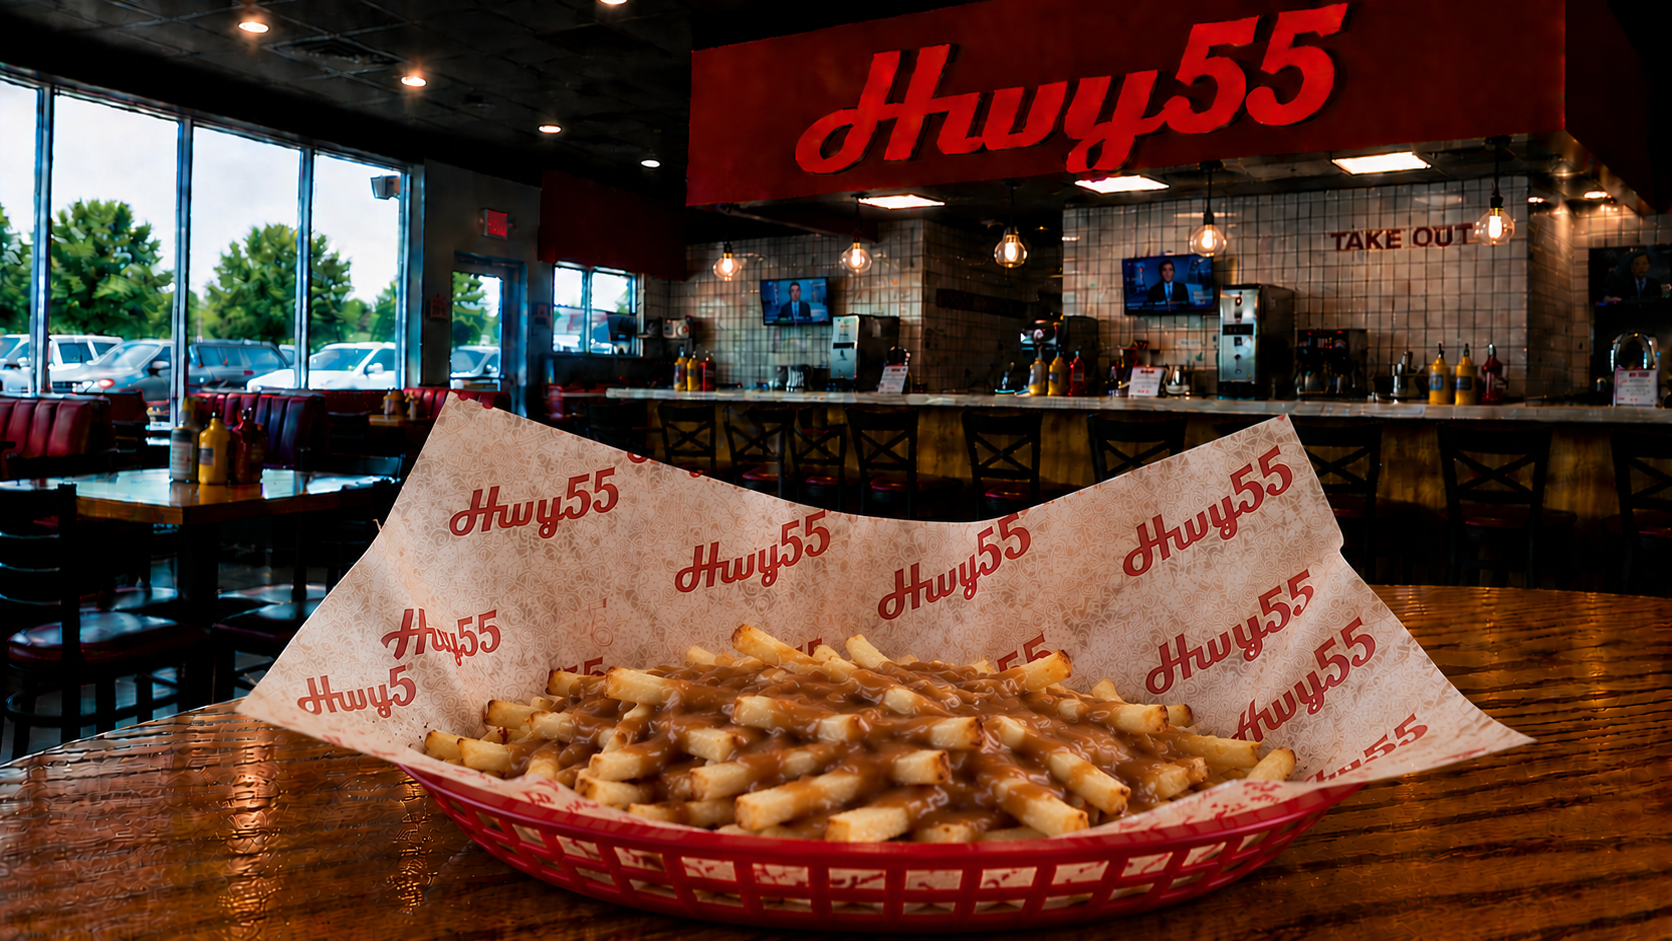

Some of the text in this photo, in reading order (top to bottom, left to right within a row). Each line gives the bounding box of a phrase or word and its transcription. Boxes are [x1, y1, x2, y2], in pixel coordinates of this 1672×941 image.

[795, 2, 1349, 174] Hwy55
[1331, 222, 1473, 251] TAKE OUT
[449, 466, 619, 539] Hwy55
[1122, 444, 1294, 577] Hwy55
[675, 510, 831, 594] Hwy55
[878, 512, 1032, 621] Hwy55
[1145, 568, 1315, 695] Hwy55
[297, 664, 417, 719] Hwy5
